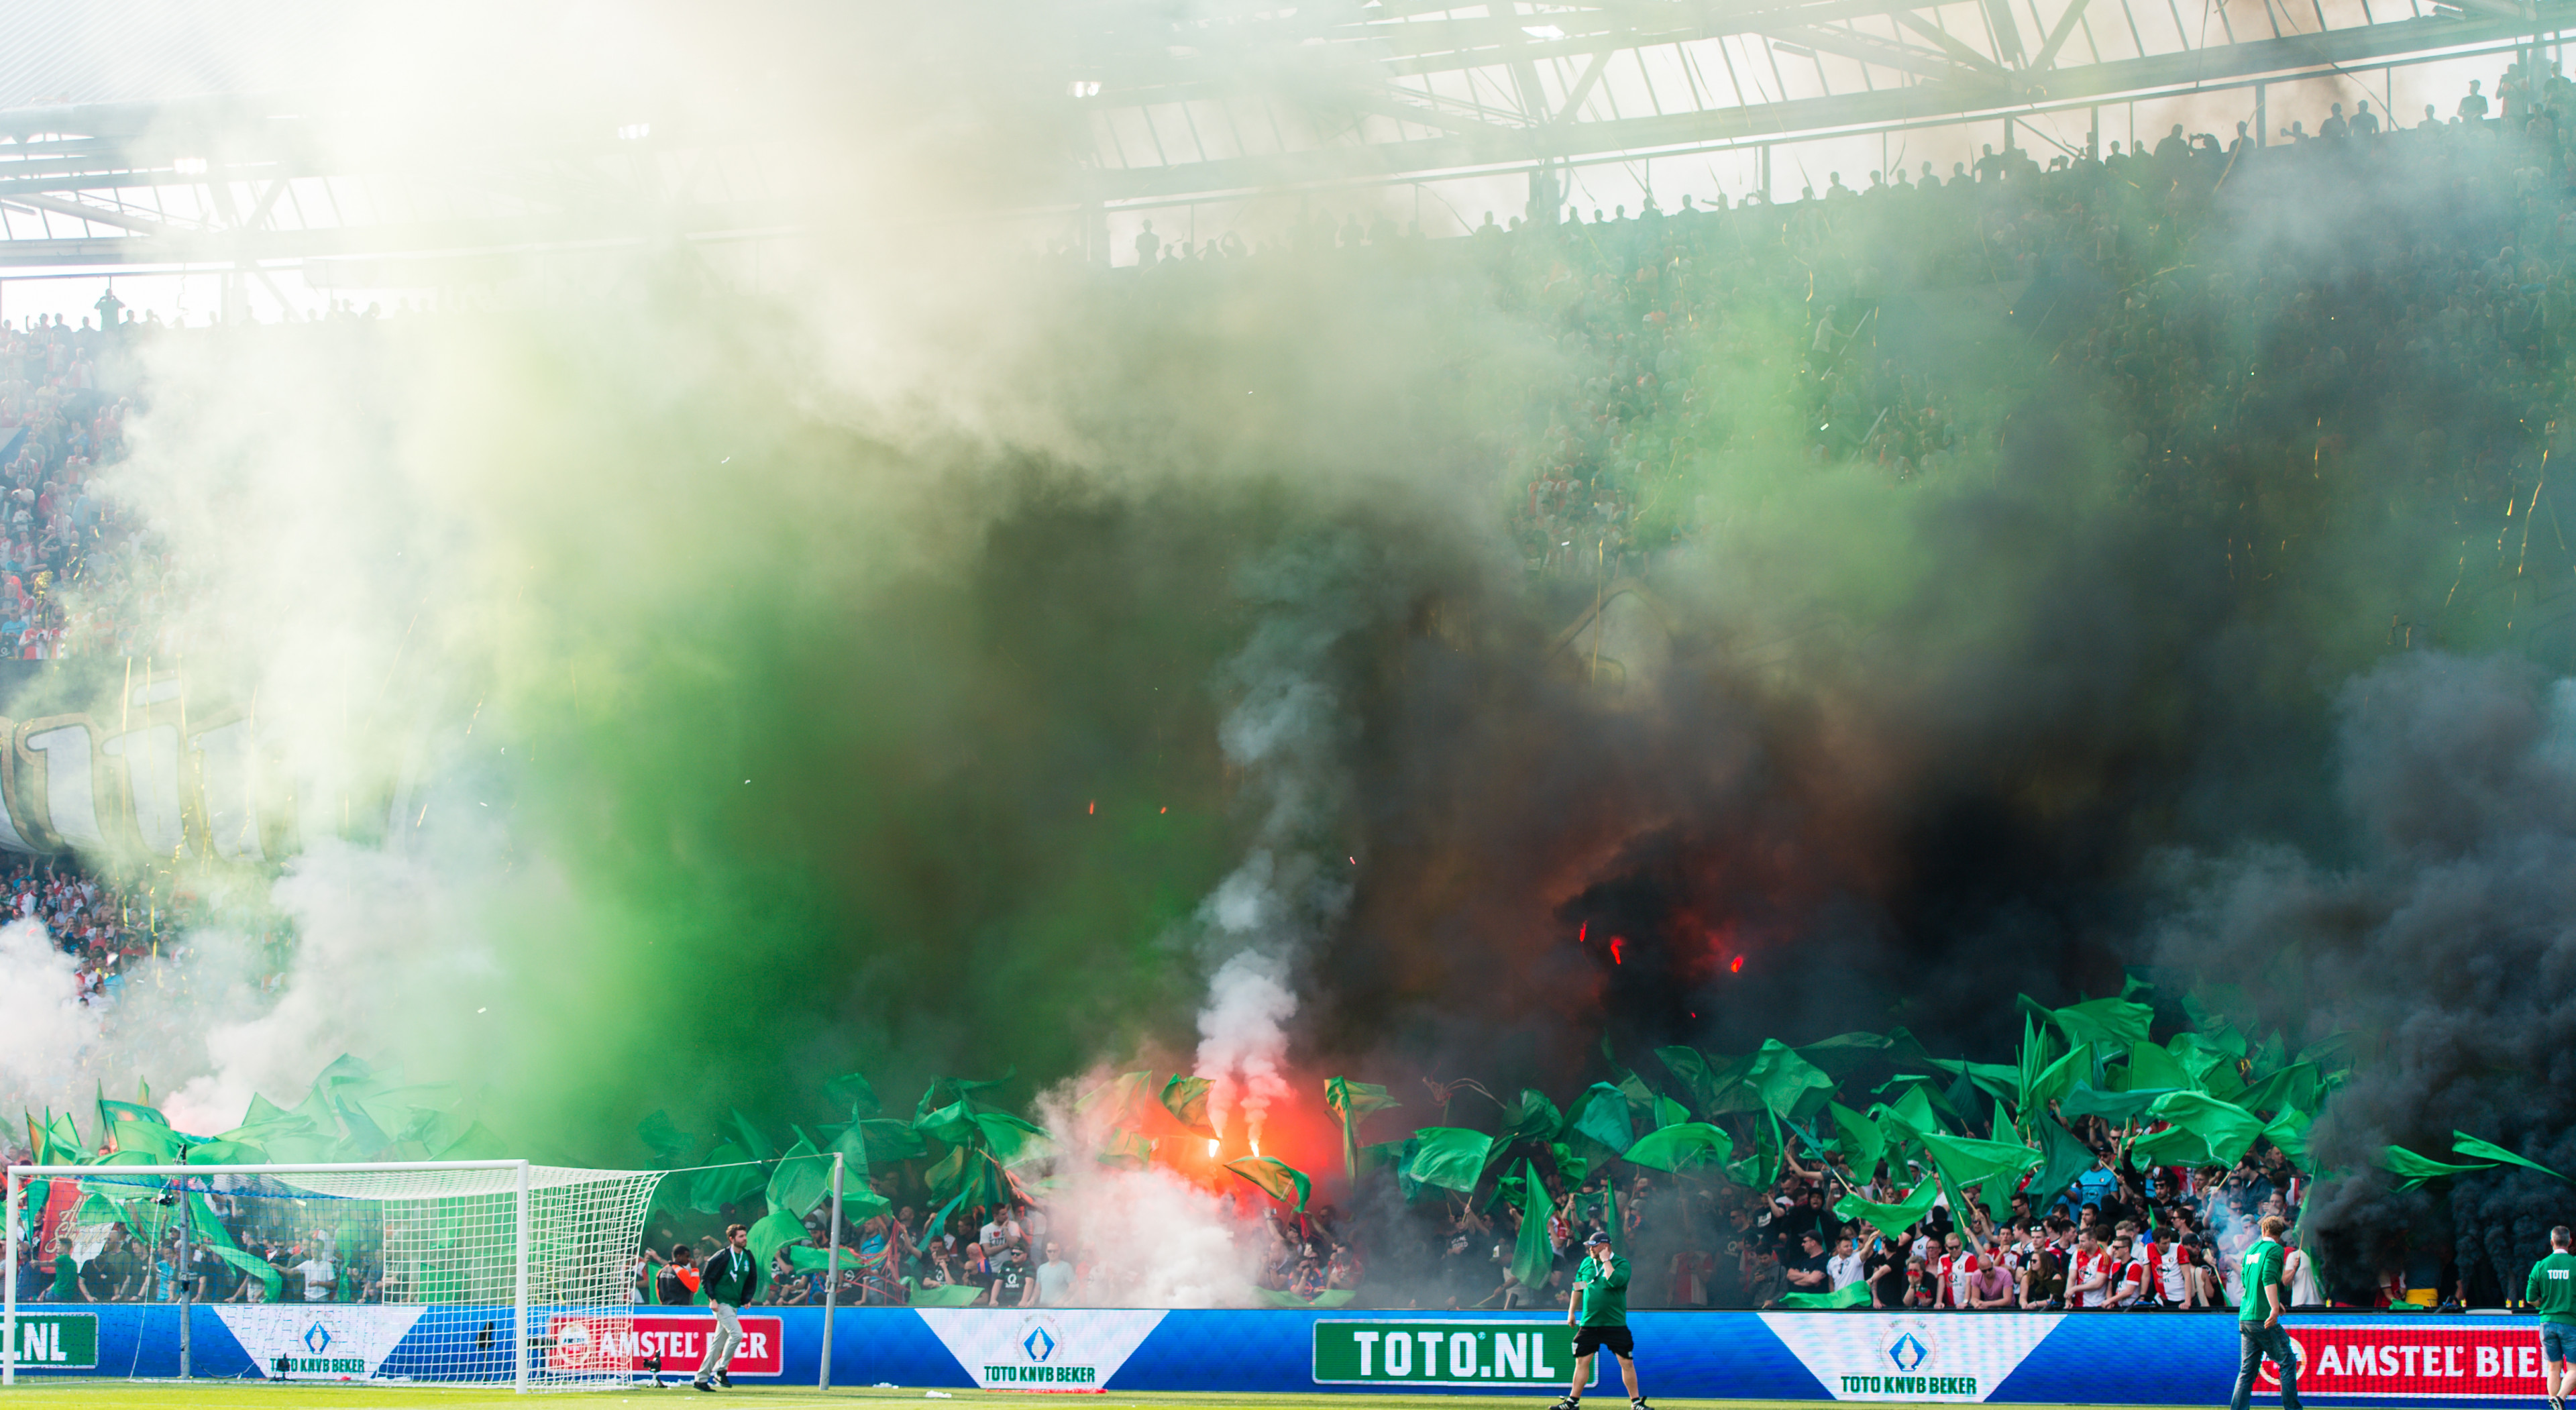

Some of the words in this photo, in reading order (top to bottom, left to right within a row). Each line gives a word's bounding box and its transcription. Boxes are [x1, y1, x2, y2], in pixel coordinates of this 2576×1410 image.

[2547, 1269, 2569, 1279] TOTO
[598, 1332, 698, 1358] AMSTEL
[1354, 1332, 1555, 1378] TOTO.NL
[2316, 1345, 2464, 1376] AMSTEL
[301, 1358, 329, 1373] KNVB
[331, 1358, 364, 1373] BEKER
[984, 1366, 1016, 1382] TOTO
[1020, 1366, 1054, 1382] KNVB
[1057, 1367, 1095, 1383] BEKER
[1841, 1376, 1880, 1393] TOTO
[1884, 1376, 1926, 1394] KNVB
[1929, 1377, 1976, 1395] BEKER
